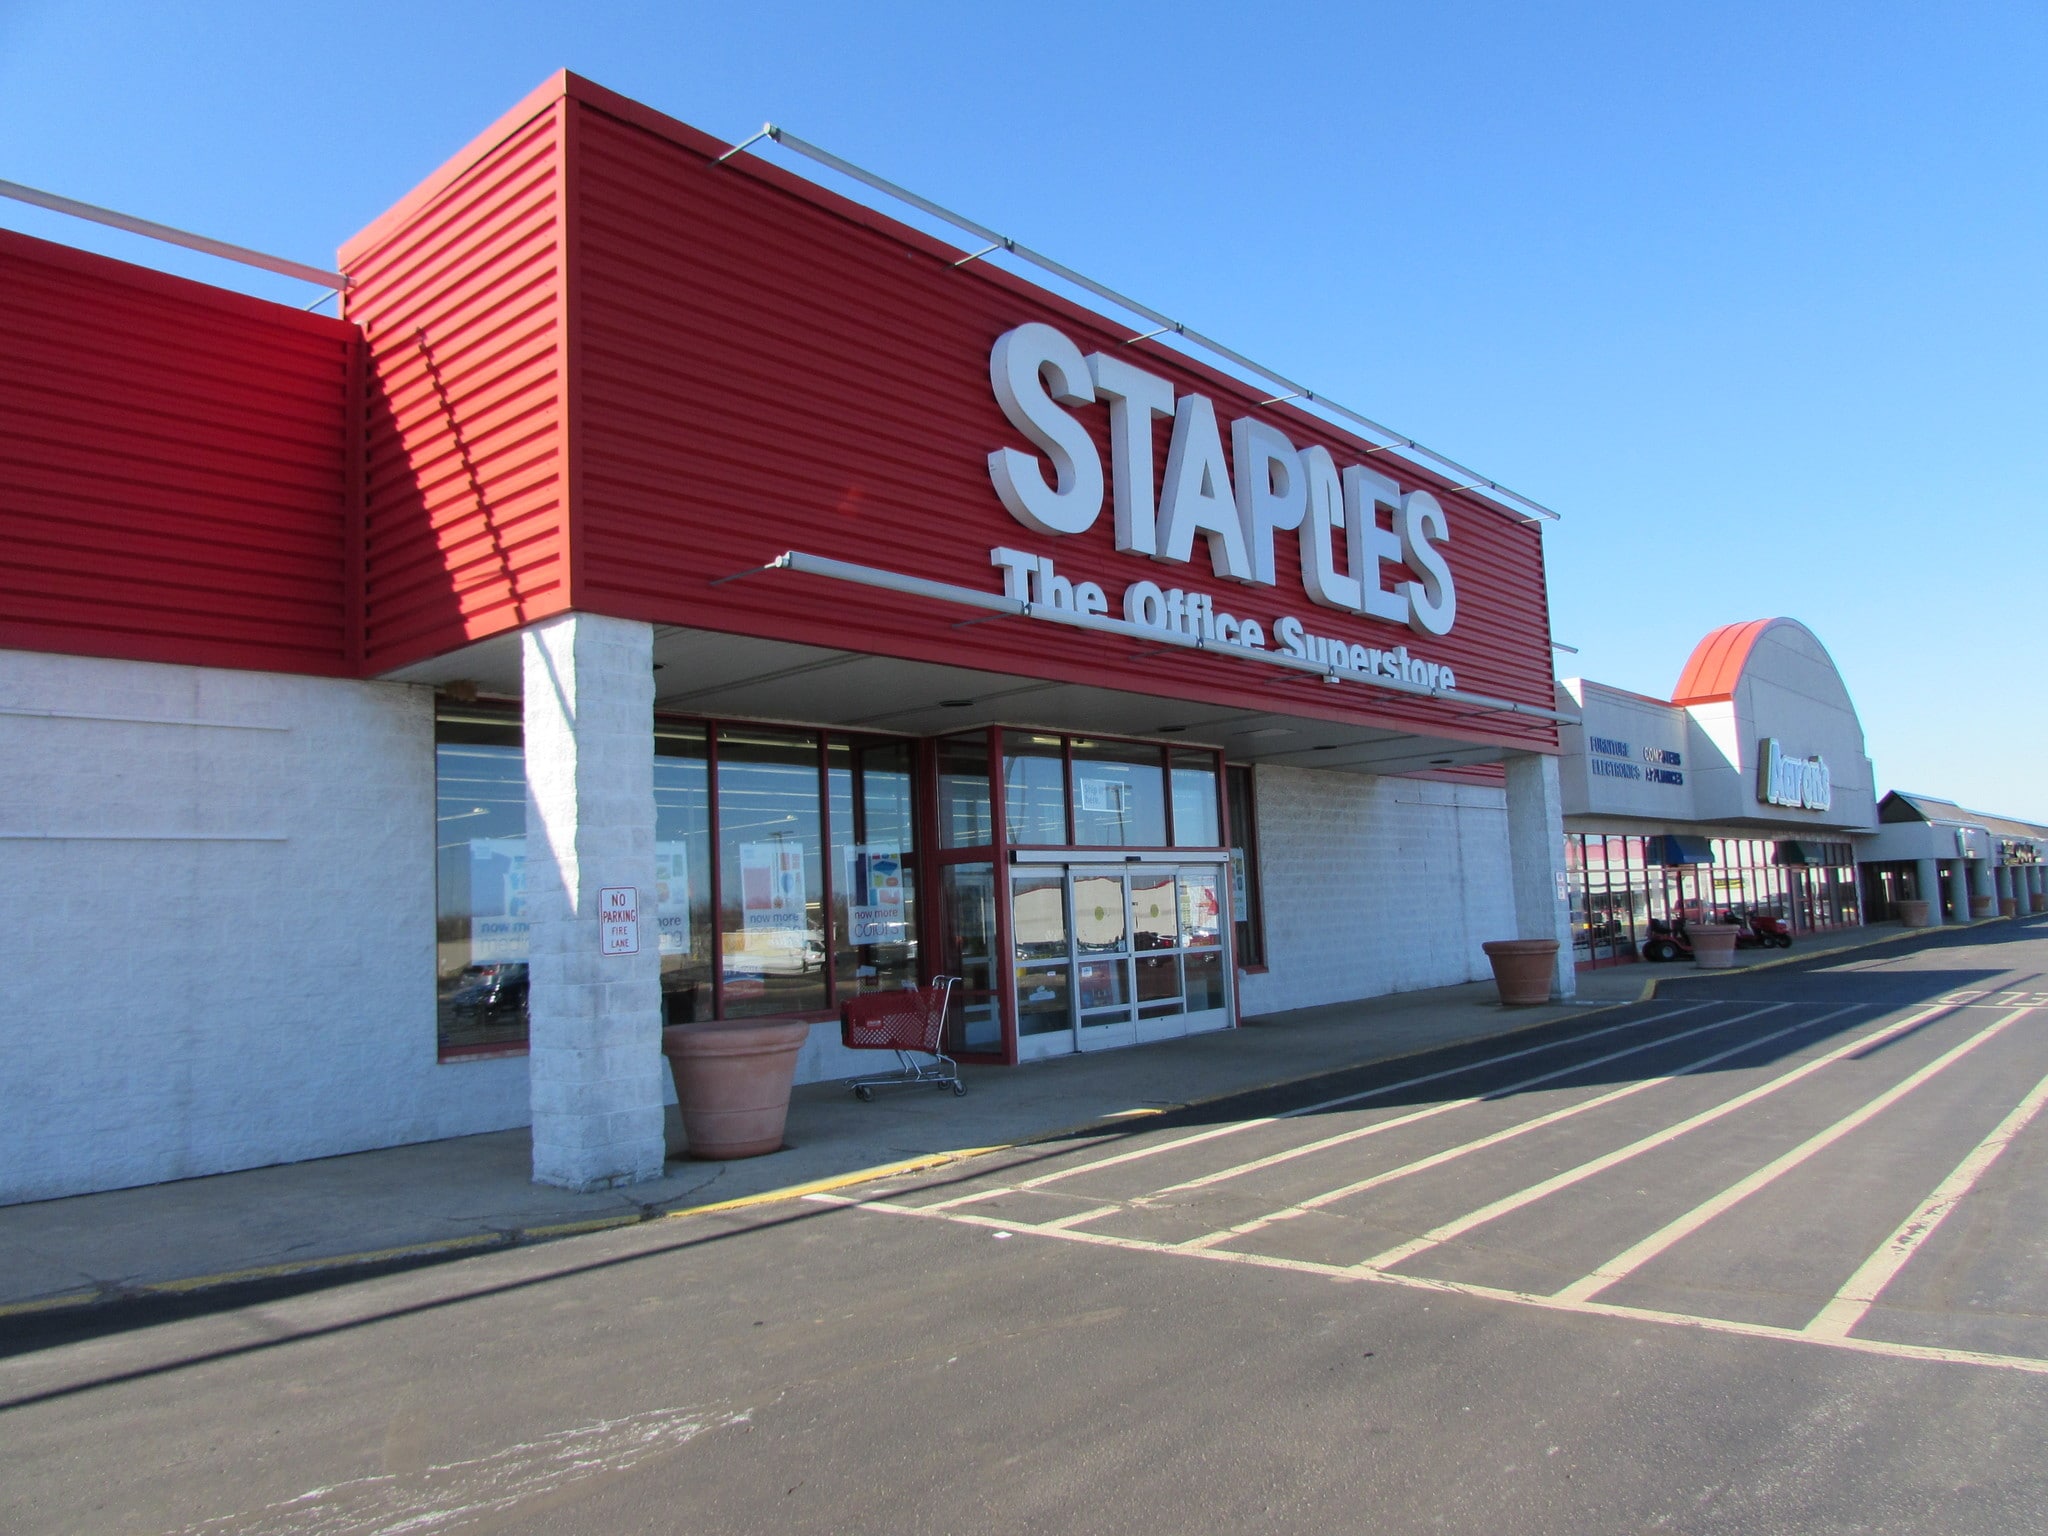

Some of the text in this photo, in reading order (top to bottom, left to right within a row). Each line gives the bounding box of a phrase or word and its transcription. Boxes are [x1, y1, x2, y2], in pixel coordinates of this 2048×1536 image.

[988, 322, 1457, 637] STAPLES
[990, 546, 1456, 692] The Office Superstore
[1590, 736, 1630, 757] FURNITURE
[1591, 759, 1641, 780] ELECTRONICS
[611, 893, 626, 907] NO
[602, 910, 636, 924] PARKING
[750, 912, 800, 923] now more
[854, 909, 898, 920] now more
[481, 921, 509, 933] now
[611, 926, 628, 936] FIRE
[611, 938, 630, 949] LANE
